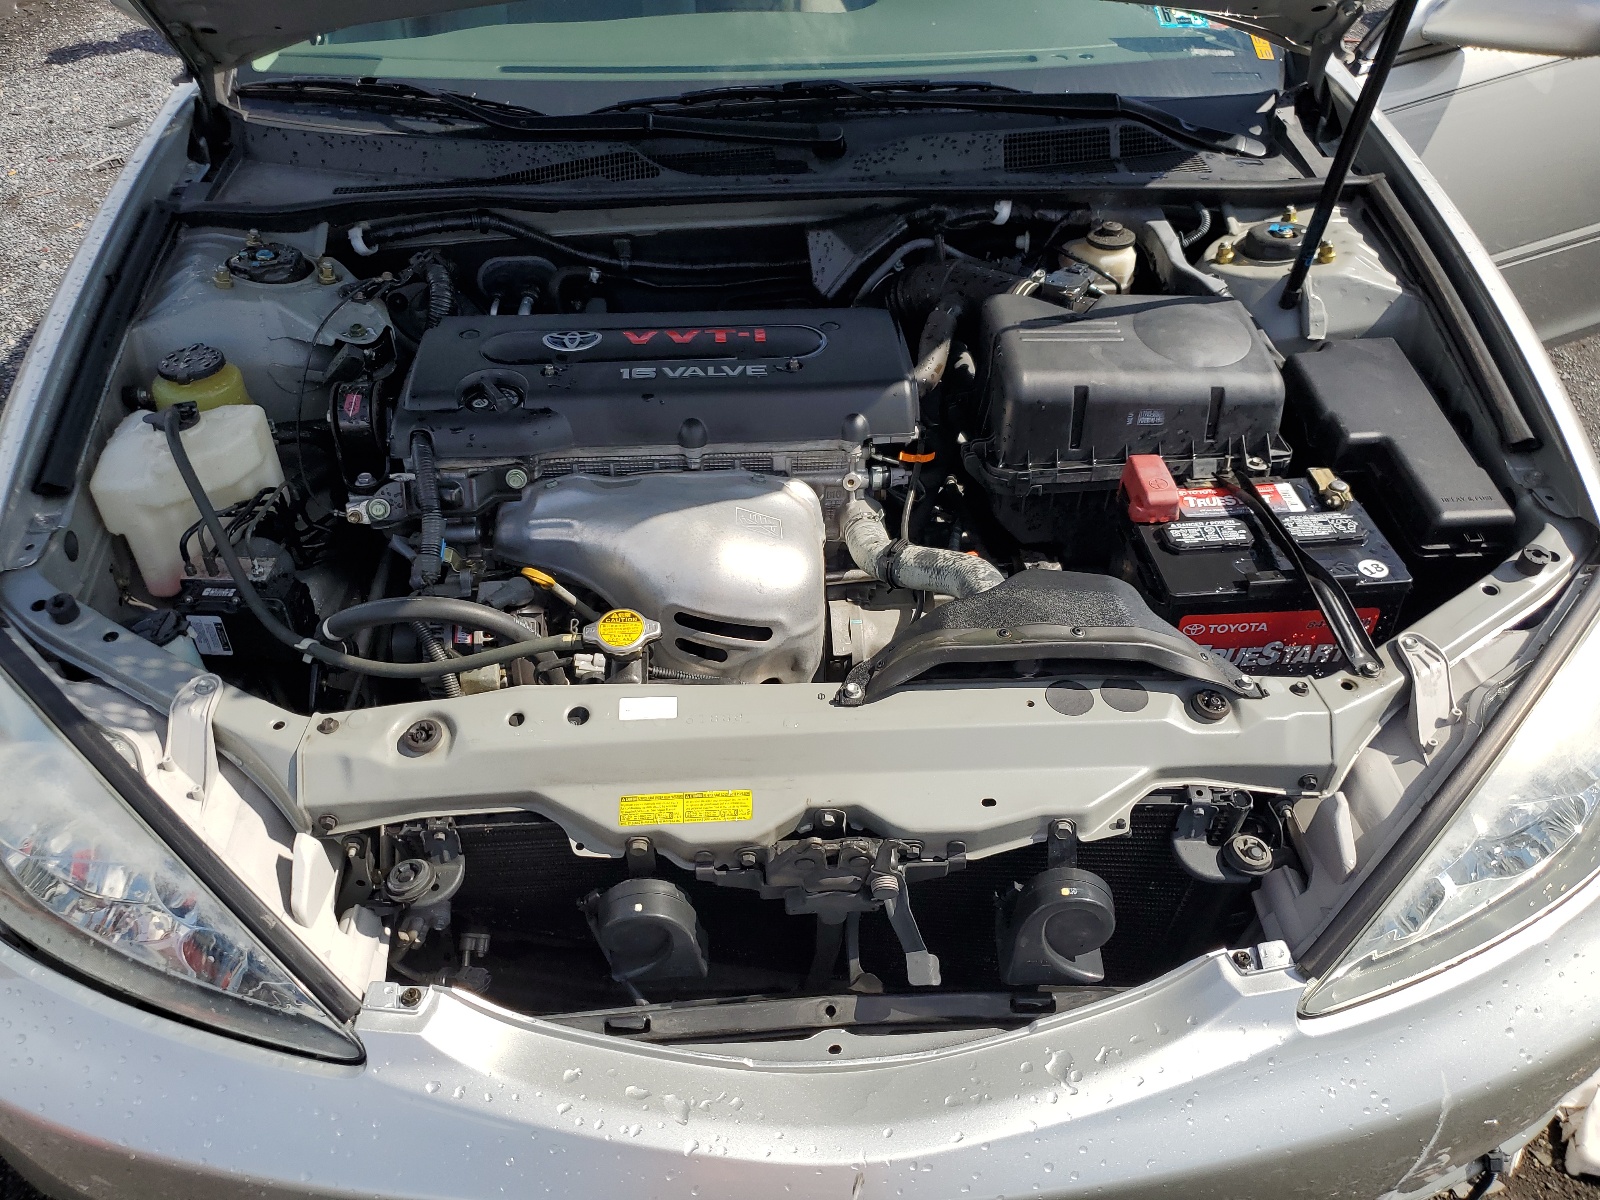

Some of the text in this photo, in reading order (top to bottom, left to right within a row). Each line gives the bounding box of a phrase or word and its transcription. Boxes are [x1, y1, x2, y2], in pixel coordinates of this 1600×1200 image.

[620, 364, 768, 380] 16 VALVE
[1208, 622, 1268, 634] TOYOTA
